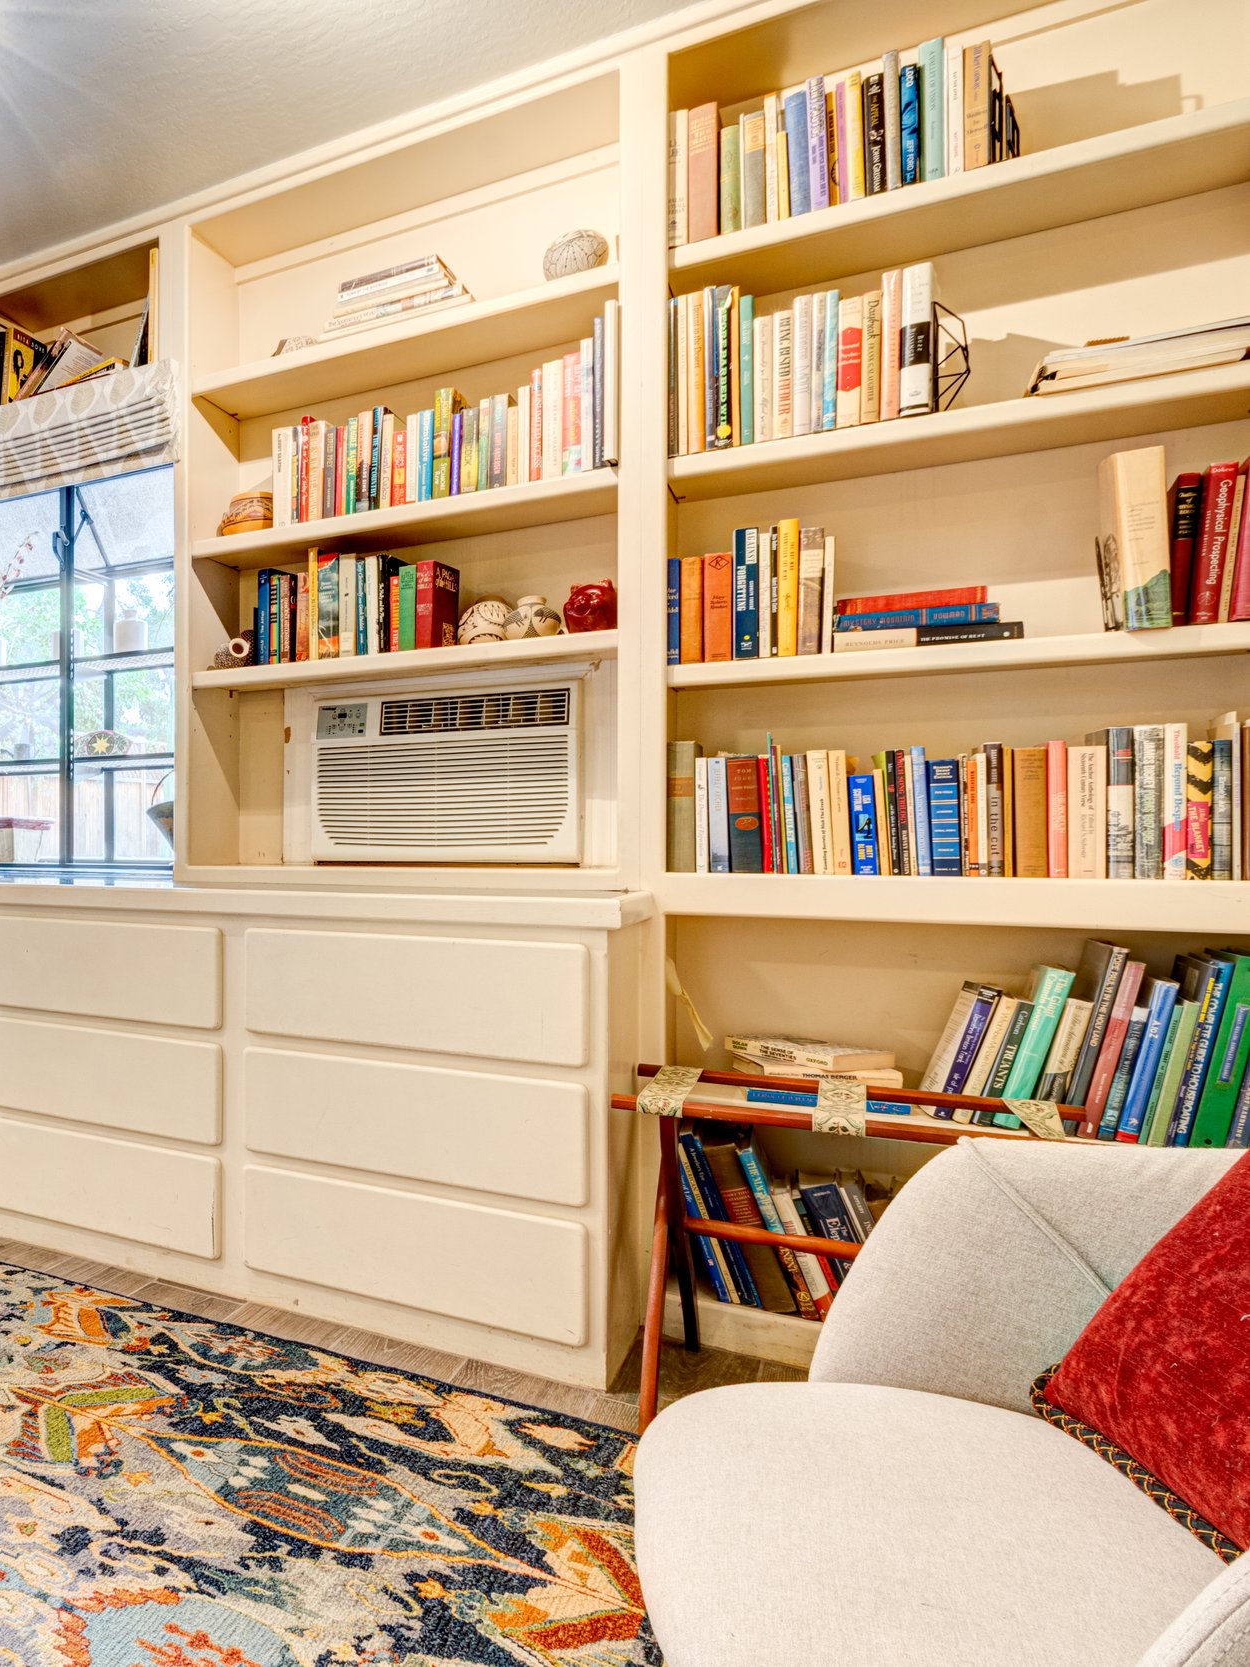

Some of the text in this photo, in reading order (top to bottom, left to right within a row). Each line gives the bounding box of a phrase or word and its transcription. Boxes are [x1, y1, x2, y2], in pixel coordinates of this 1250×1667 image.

[905, 66, 916, 87] LOCO
[871, 103, 880, 126] APPEAL
[871, 145, 882, 192] JOHN GRISHAM
[906, 140, 915, 171] JEFF FORD
[778, 317, 791, 416] BEING BUSTED FIEDLER
[533, 439, 541, 468] ACCESS
[746, 530, 756, 563] AGAINST
[1205, 479, 1232, 585] Geophysical Prospecting
[737, 565, 746, 611] FORGETTING
[1173, 730, 1181, 760] Theobald
[896, 776, 904, 794] SONG
[1079, 776, 1088, 794] Century
[1143, 741, 1155, 813] JAMES DICKEY POEMS
[1173, 763, 1183, 796] Beyond
[1086, 781, 1094, 804] Anthology
[784, 803, 794, 842] AMULET
[897, 797, 905, 825] TRILOGY
[991, 796, 999, 856] in the cut
[1188, 806, 1205, 853] THE BLANKET
[1110, 954, 1123, 972] POPE
[1038, 973, 1056, 1007] Canada
[1106, 971, 1119, 987] PAUL
[1211, 982, 1223, 998] THE
[1045, 977, 1069, 1018] The Giant
[1098, 1001, 1110, 1014] THE
[1013, 1010, 1028, 1035] Carlson
[1093, 1014, 1106, 1029] HOLY
[1200, 998, 1218, 1038] COMPLETE
[1089, 1029, 1101, 1047] LAND
[1125, 1030, 1140, 1060] HARMONY
[1196, 1039, 1211, 1062] GUIDE
[772, 1051, 797, 1061] SEVENTIES
[806, 1057, 828, 1066] OXFORD
[994, 1044, 1018, 1089] TRUANTS
[1192, 1063, 1204, 1074] TO
[1177, 1073, 1202, 1134] HOUSEBOATING
[682, 1160, 698, 1192] AMERICAN
[698, 1172, 706, 1181] Eye
[746, 1160, 759, 1177] THE
